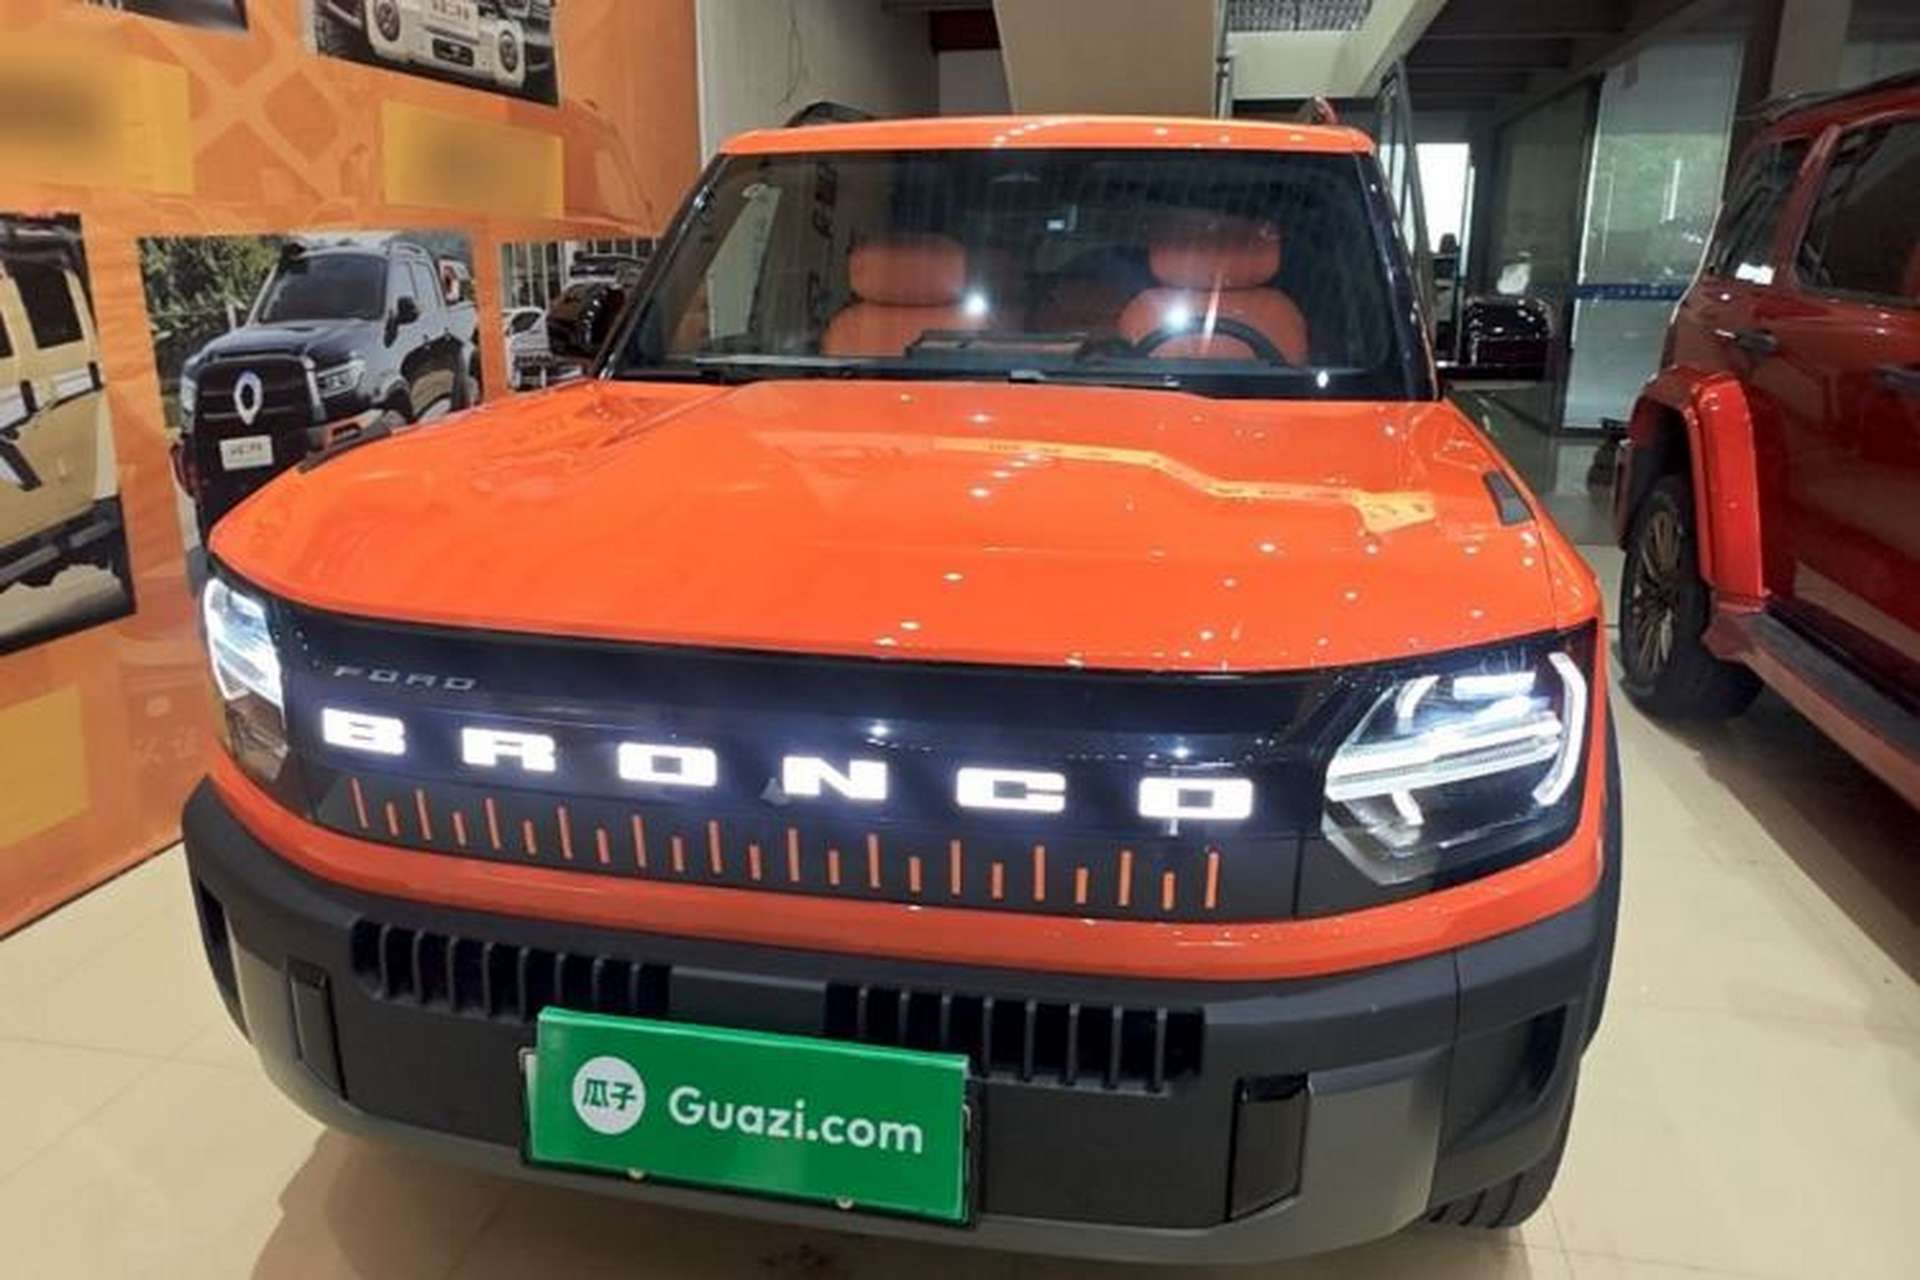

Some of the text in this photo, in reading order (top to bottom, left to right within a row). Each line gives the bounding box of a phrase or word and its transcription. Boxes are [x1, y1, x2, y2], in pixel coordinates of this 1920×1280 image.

[333, 665, 476, 690] FORD
[321, 707, 1255, 821] BRONCO
[582, 1078, 637, 1111] 瓜子
[668, 1085, 924, 1154] Guazi.com
